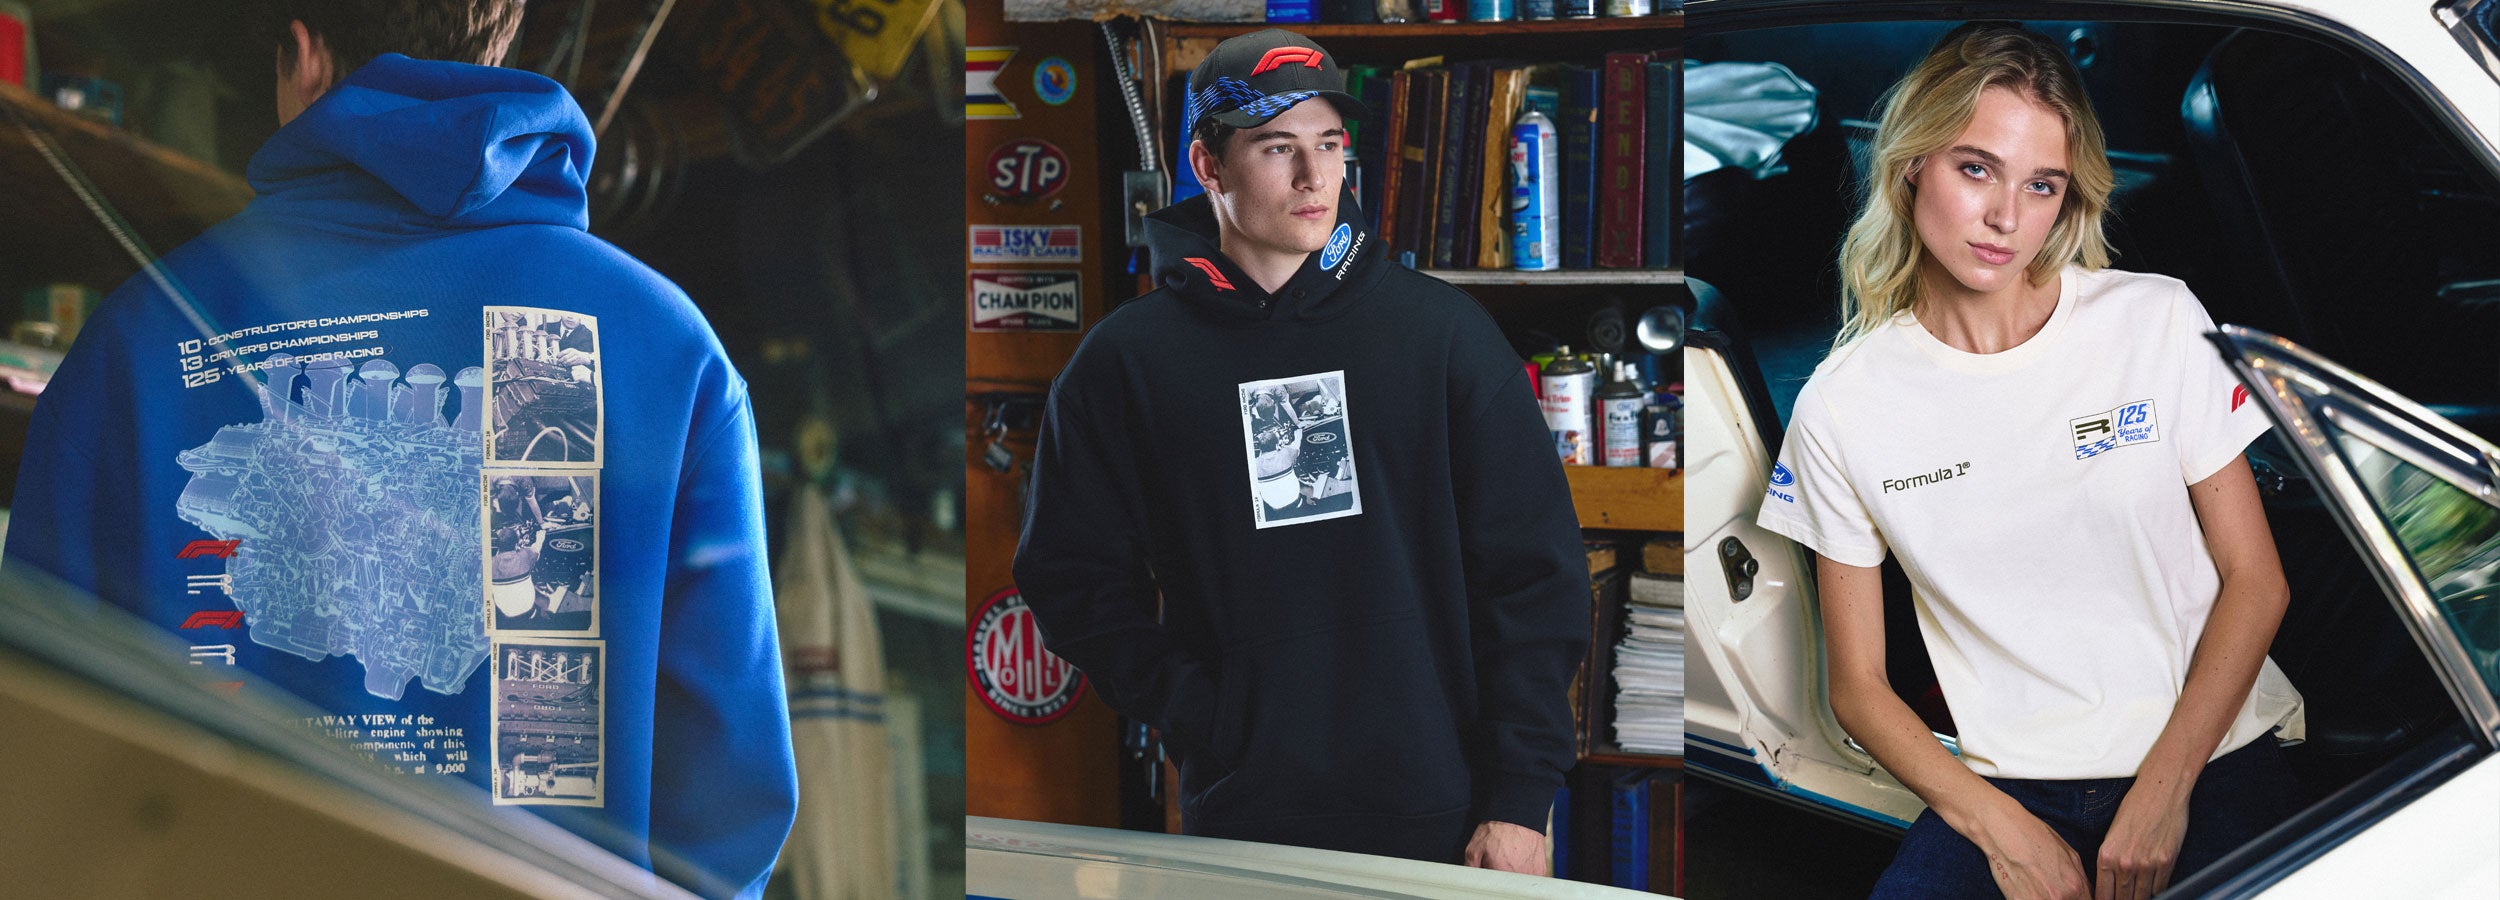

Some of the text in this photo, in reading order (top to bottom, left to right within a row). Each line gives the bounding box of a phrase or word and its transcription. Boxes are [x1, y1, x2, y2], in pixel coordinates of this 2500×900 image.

[994, 145, 1061, 192] STP
[1611, 67, 1632, 256] BENDIX
[1004, 229, 1050, 247] ISKY
[1336, 230, 1366, 281] RACING
[977, 292, 1074, 310] CHAMPION
[178, 309, 429, 355] 10 CONSTRUCTOR'S CHAMPIONSHIPS
[180, 330, 379, 371] 13 DRIVER'S CHAMPIONSHIPS
[182, 347, 385, 389] 125 YEARS OF FORD RACING
[2117, 403, 2147, 428] 125
[2117, 424, 2154, 438] Years of
[2125, 433, 2149, 442] RACING
[1882, 468, 1953, 494] Formula
[987, 688, 1029, 717] SINCE
[361, 714, 397, 726] VIEW
[401, 714, 413, 726] of
[417, 714, 434, 726] the
[370, 727, 406, 739] engine
[416, 726, 464, 738] showing
[350, 738, 466, 752] components of this
[394, 751, 427, 762] which
[446, 750, 468, 762] will
[435, 763, 466, 776] 9,000
